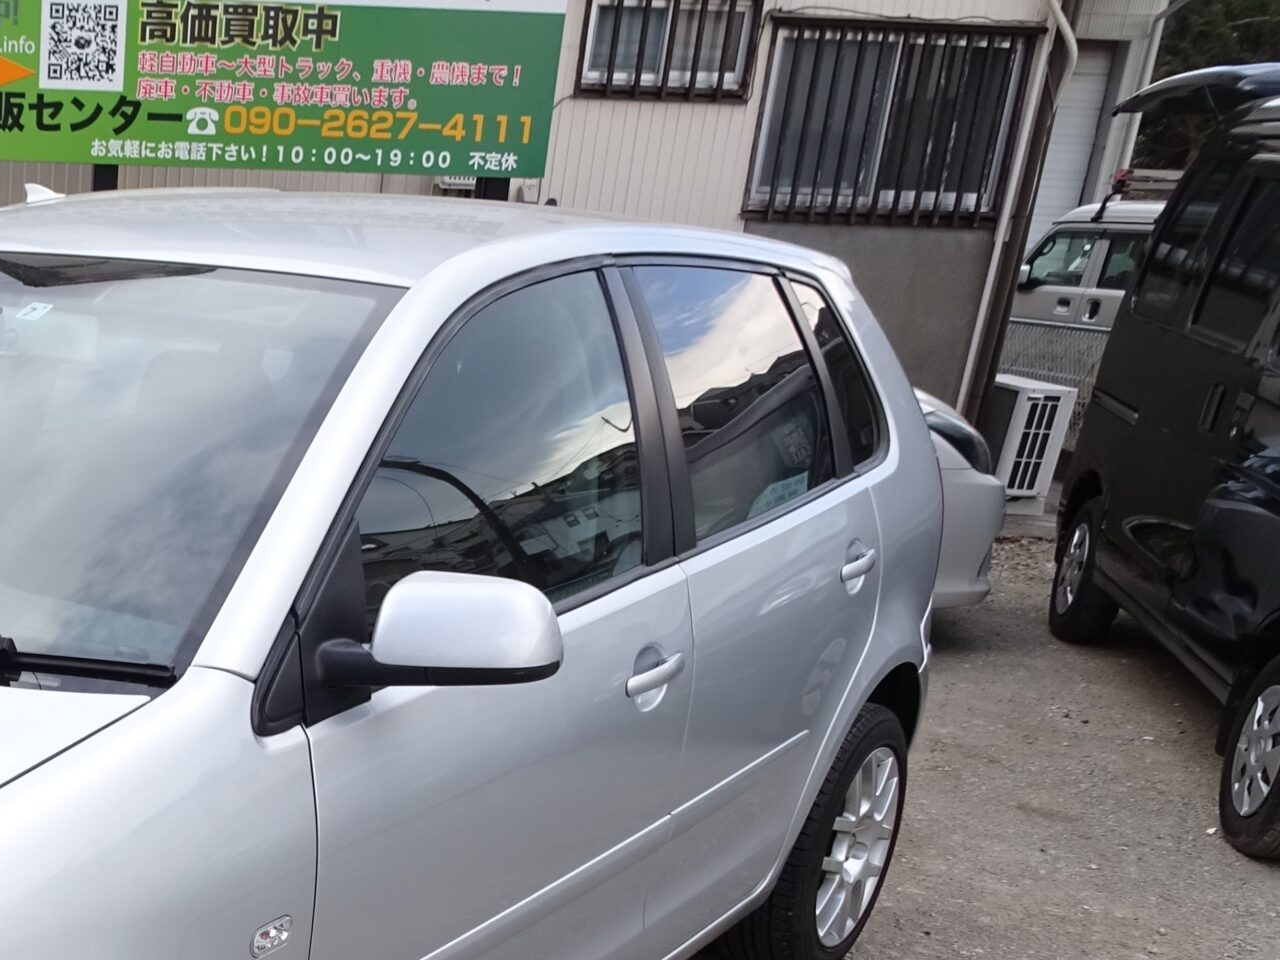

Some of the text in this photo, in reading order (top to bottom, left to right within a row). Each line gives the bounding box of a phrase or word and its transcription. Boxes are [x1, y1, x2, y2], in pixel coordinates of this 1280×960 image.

[138, 0, 340, 51] 高価買取中
[224, 105, 532, 144] 090-2627-4111
[468, 151, 518, 171] 不定休
